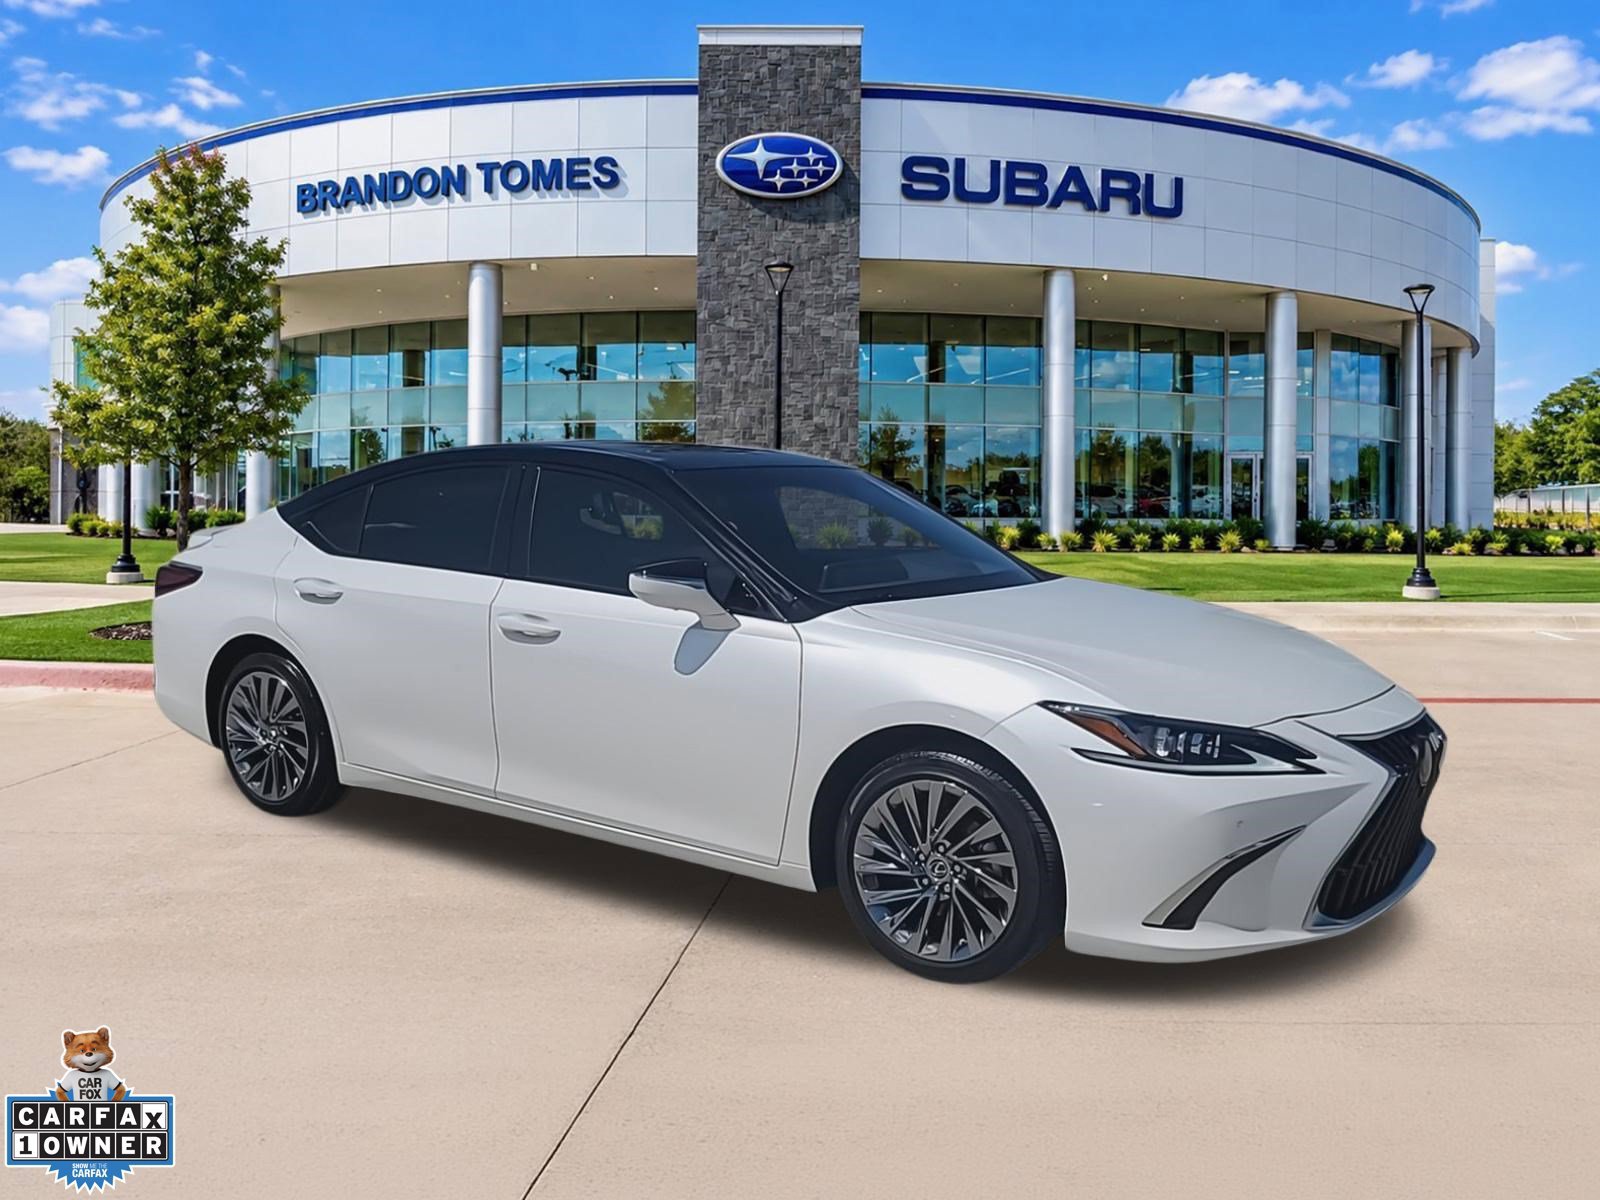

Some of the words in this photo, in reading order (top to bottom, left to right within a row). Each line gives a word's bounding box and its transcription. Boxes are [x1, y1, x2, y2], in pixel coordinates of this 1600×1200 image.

[296, 164, 466, 213] BRANDON
[476, 156, 621, 194] TOMES
[901, 155, 1184, 218] SUBARU
